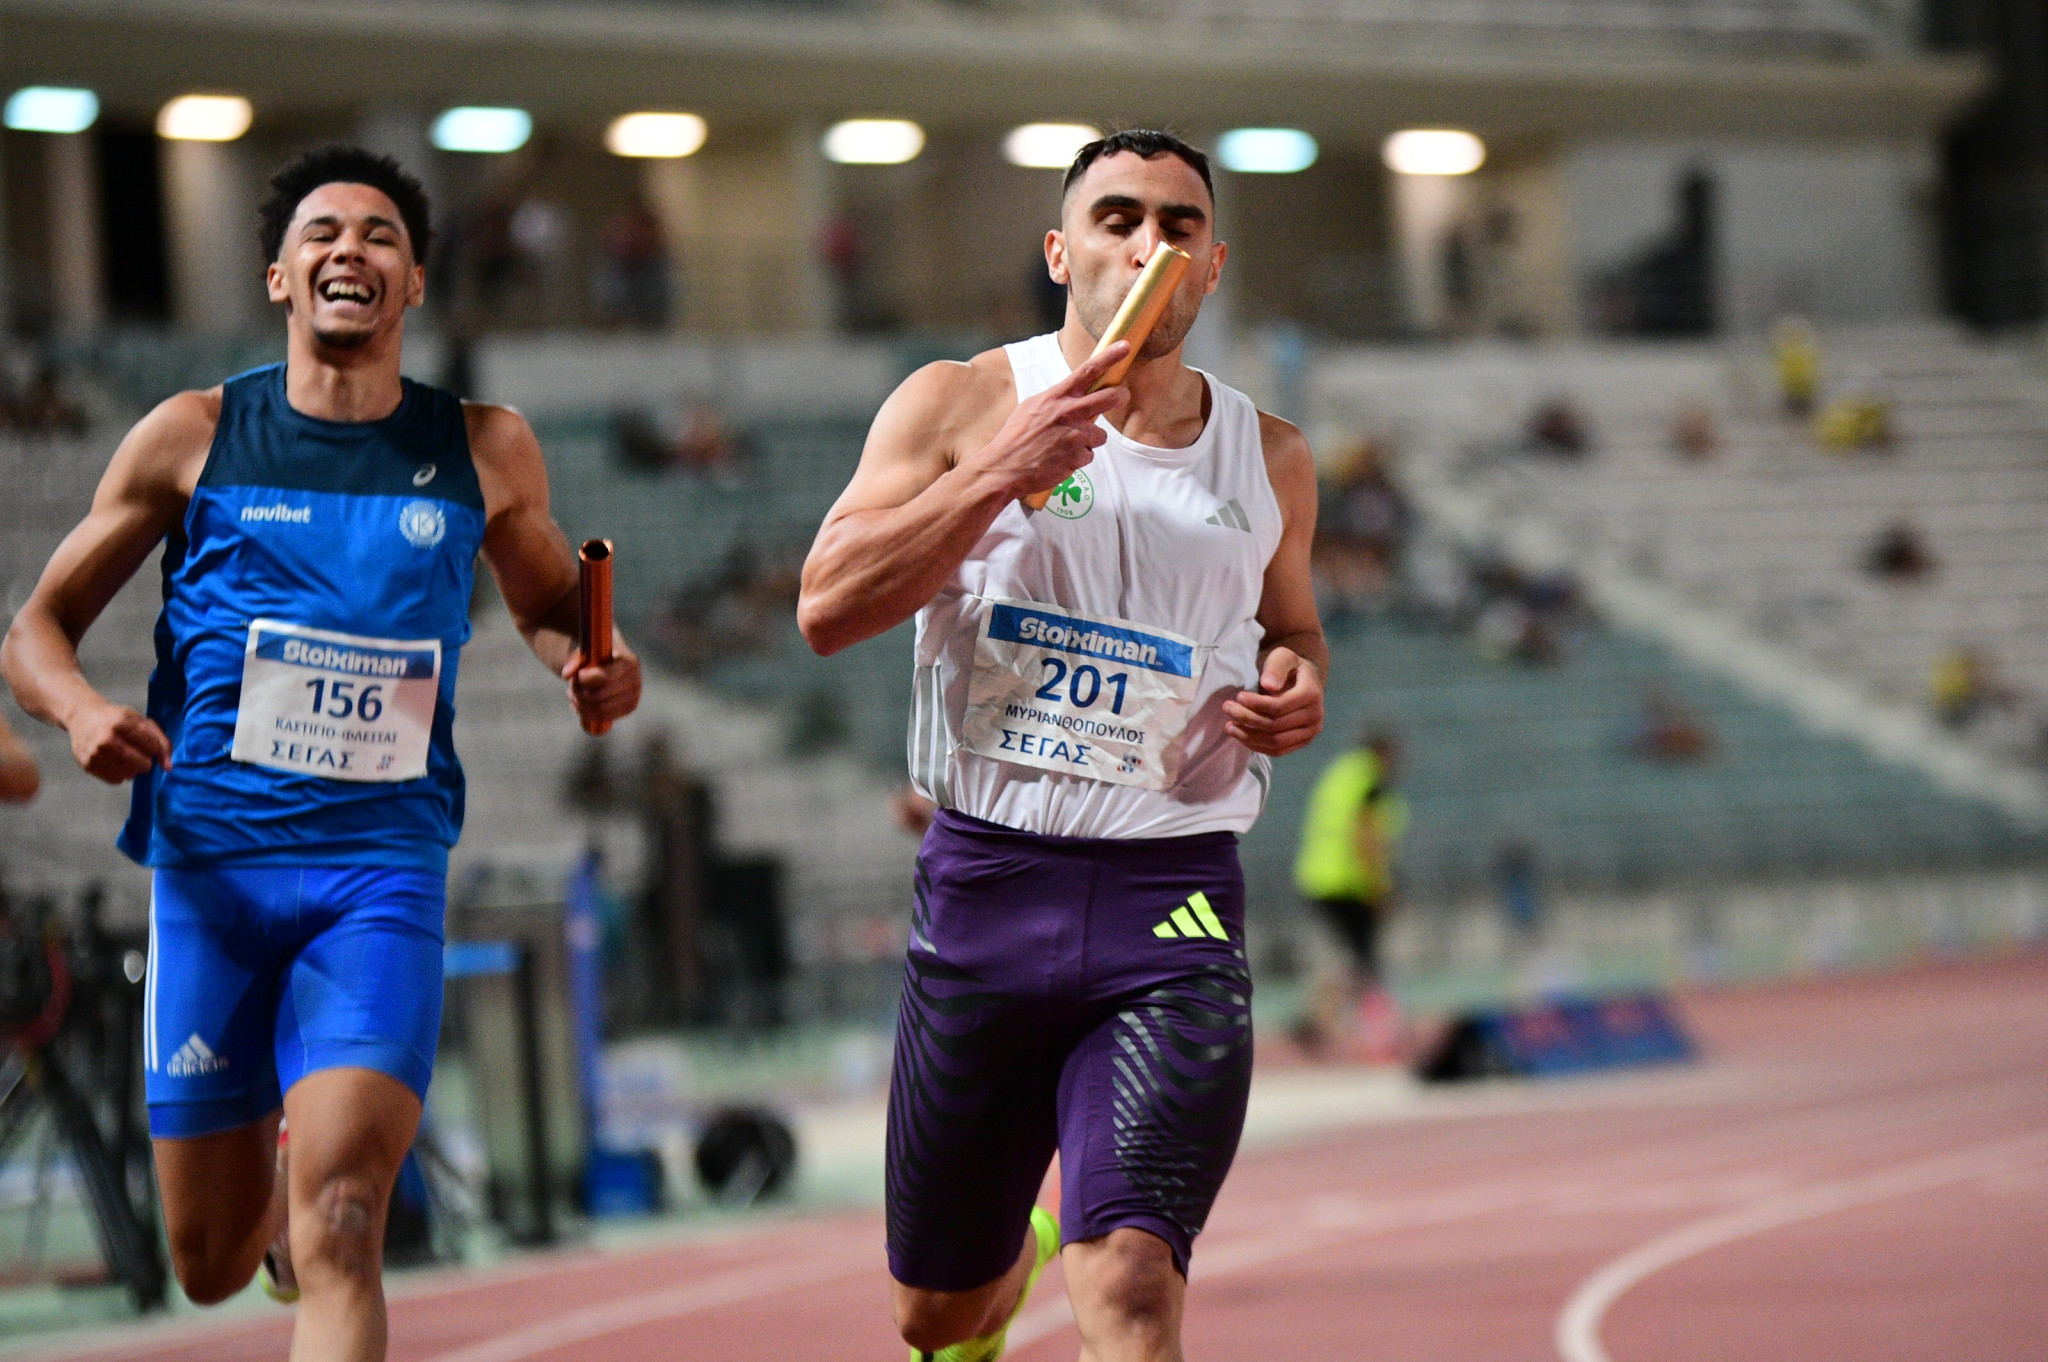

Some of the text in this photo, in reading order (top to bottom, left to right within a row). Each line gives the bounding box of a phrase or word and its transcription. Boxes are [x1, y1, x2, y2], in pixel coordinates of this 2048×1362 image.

[241, 503, 312, 524] novibet
[306, 677, 382, 723] 156
[1035, 657, 1129, 715] 201
[1005, 703, 1146, 744] ΜΥΡΙΑΝΘΟΠΟΥΛΟΣ
[271, 739, 355, 771] ΣΕΓΑΣ
[999, 729, 1092, 766] ΣΕΓΑΣ
